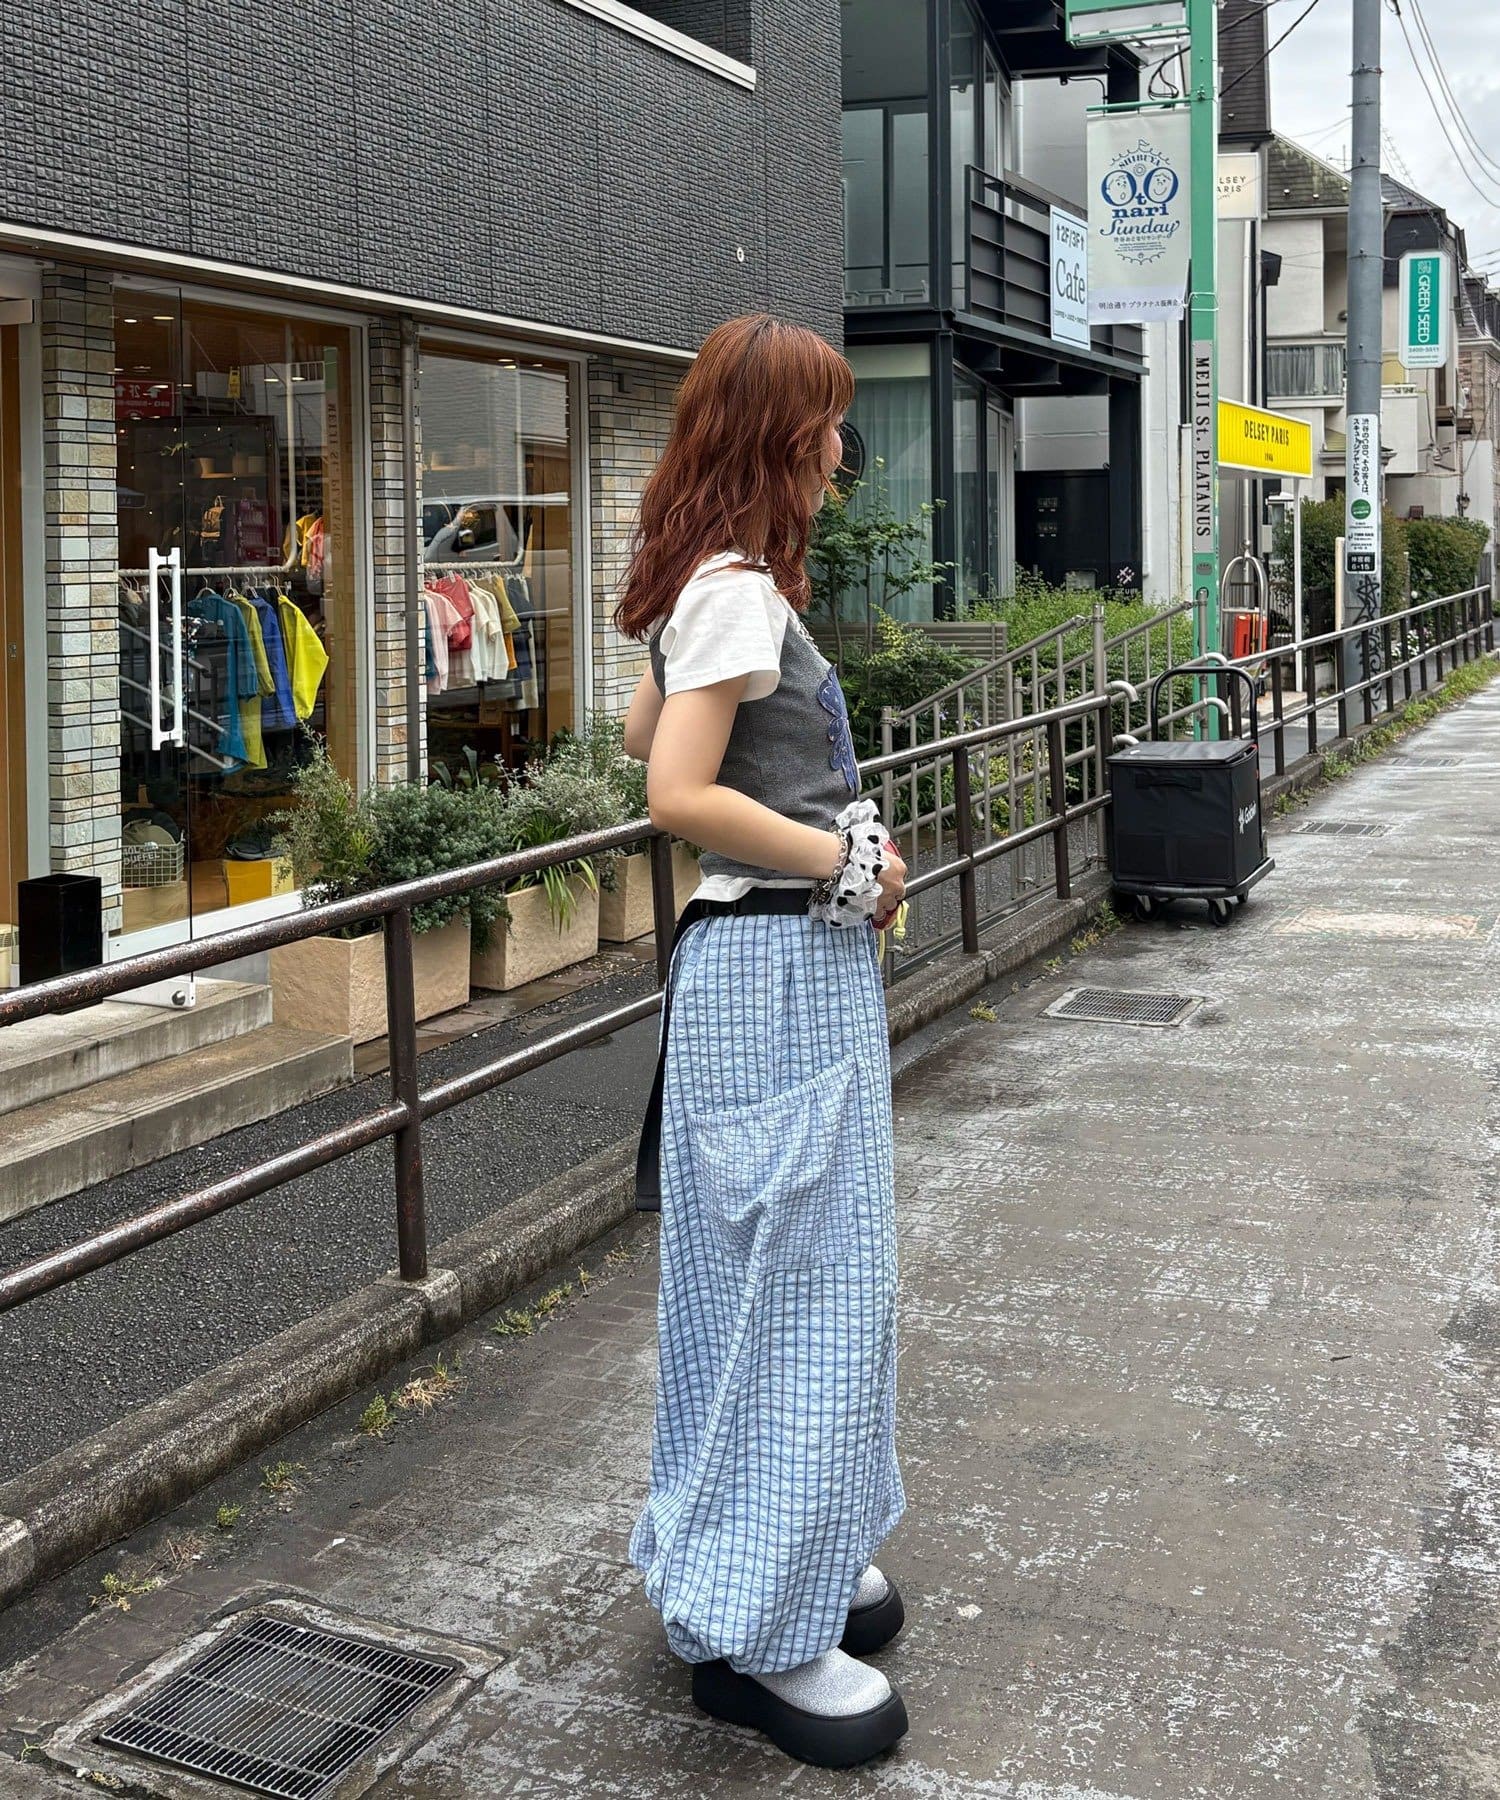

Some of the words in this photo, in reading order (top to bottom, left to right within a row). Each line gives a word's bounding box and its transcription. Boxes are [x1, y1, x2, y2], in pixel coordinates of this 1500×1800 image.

[1119, 154, 1161, 168] SHIBUYA
[1099, 217, 1180, 238] Sunday
[1056, 258, 1086, 305] Cafe
[1418, 275, 1430, 313] GREEN
[1417, 314, 1430, 343] SEED
[1196, 357, 1210, 407] MEIJI
[1196, 415, 1210, 441] St.
[1244, 419, 1269, 442] DELSEY
[1271, 426, 1289, 446] PARIS
[1196, 451, 1211, 537] PLATANUS
